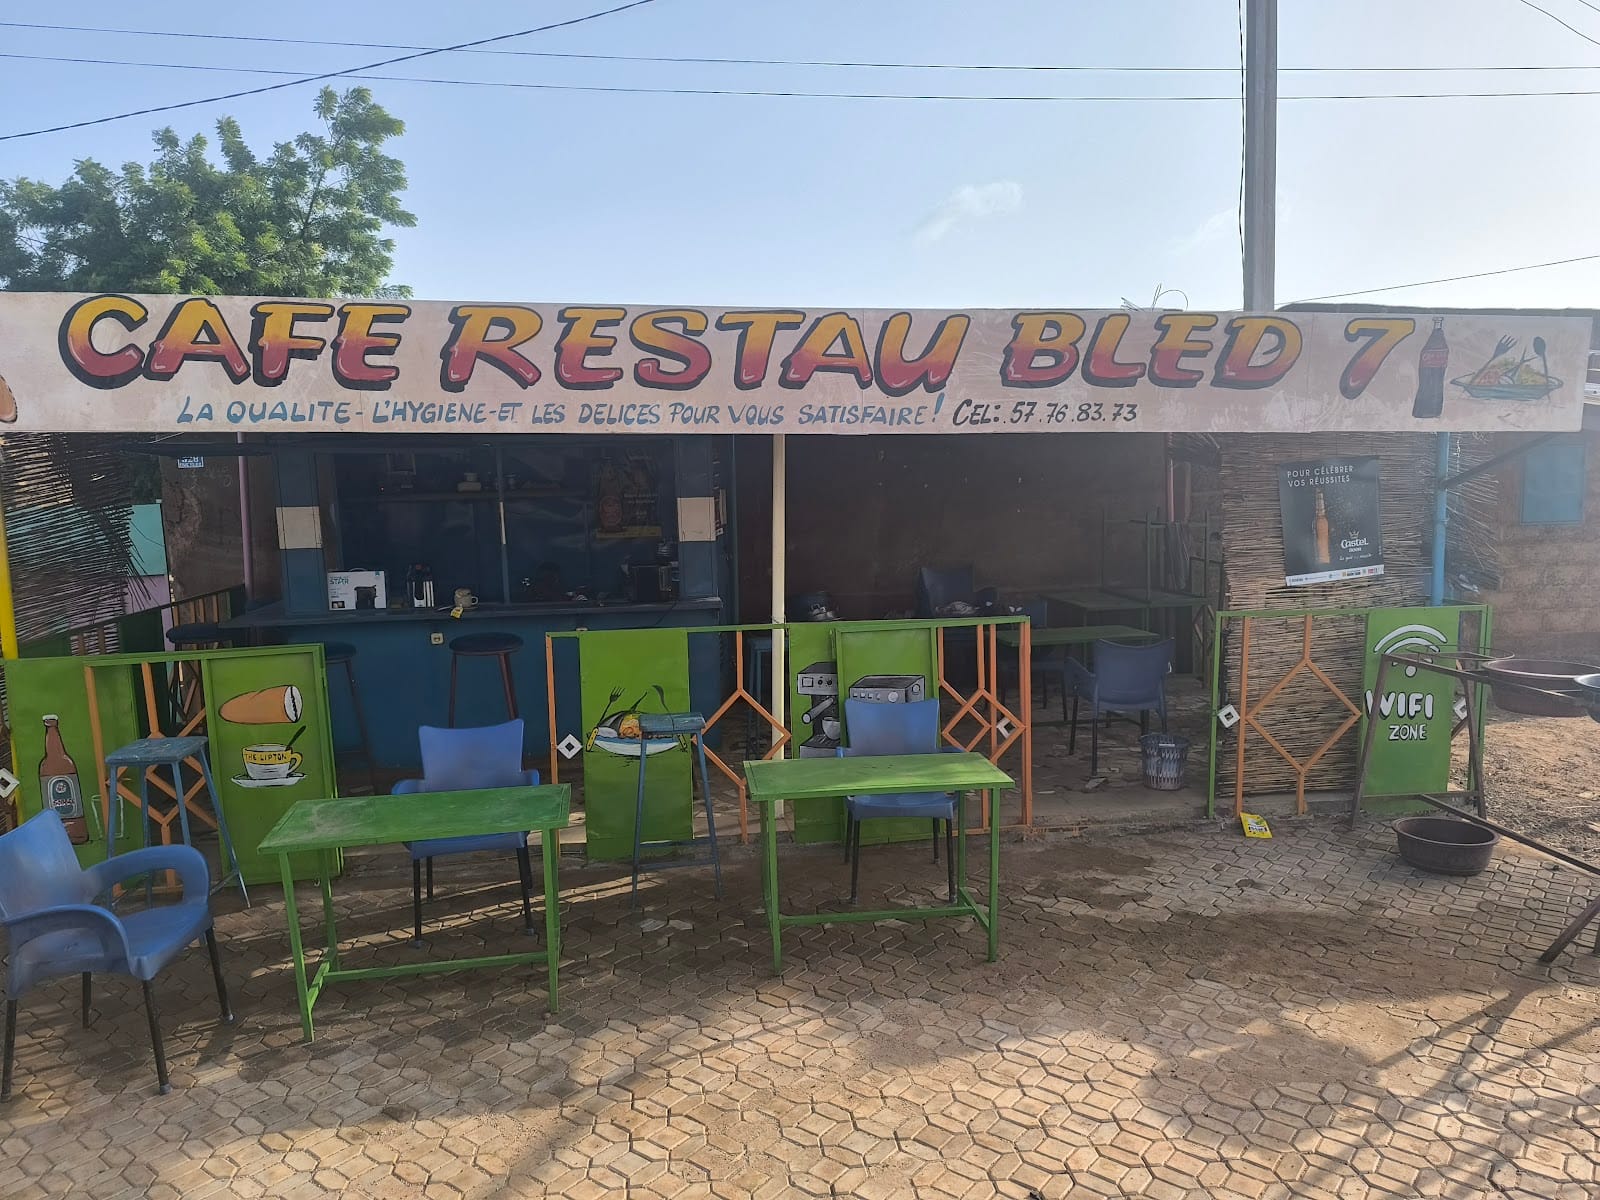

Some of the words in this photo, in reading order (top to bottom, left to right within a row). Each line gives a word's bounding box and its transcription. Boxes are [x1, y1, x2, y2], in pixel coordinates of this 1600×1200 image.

[58, 293, 411, 390] CAFE
[439, 304, 971, 398] RESTAU
[1000, 311, 1304, 389] BLED
[1339, 317, 1416, 400] 7
[176, 396, 214, 424] LA
[531, 402, 566, 425] LES
[578, 402, 662, 425] DELICES
[668, 402, 721, 425] POUR
[727, 404, 786, 425] VOUS
[1287, 469, 1311, 479] POUR
[1314, 465, 1354, 475] CÉLÉBRER
[1287, 479, 1306, 488] VOS
[1310, 475, 1350, 486] RÉUSSITES
[1340, 537, 1369, 549] Castel
[1365, 689, 1435, 720] WIFI
[1388, 723, 1428, 741] ZONE
[244, 753, 257, 761] THE
[260, 753, 286, 761] LIPTON
